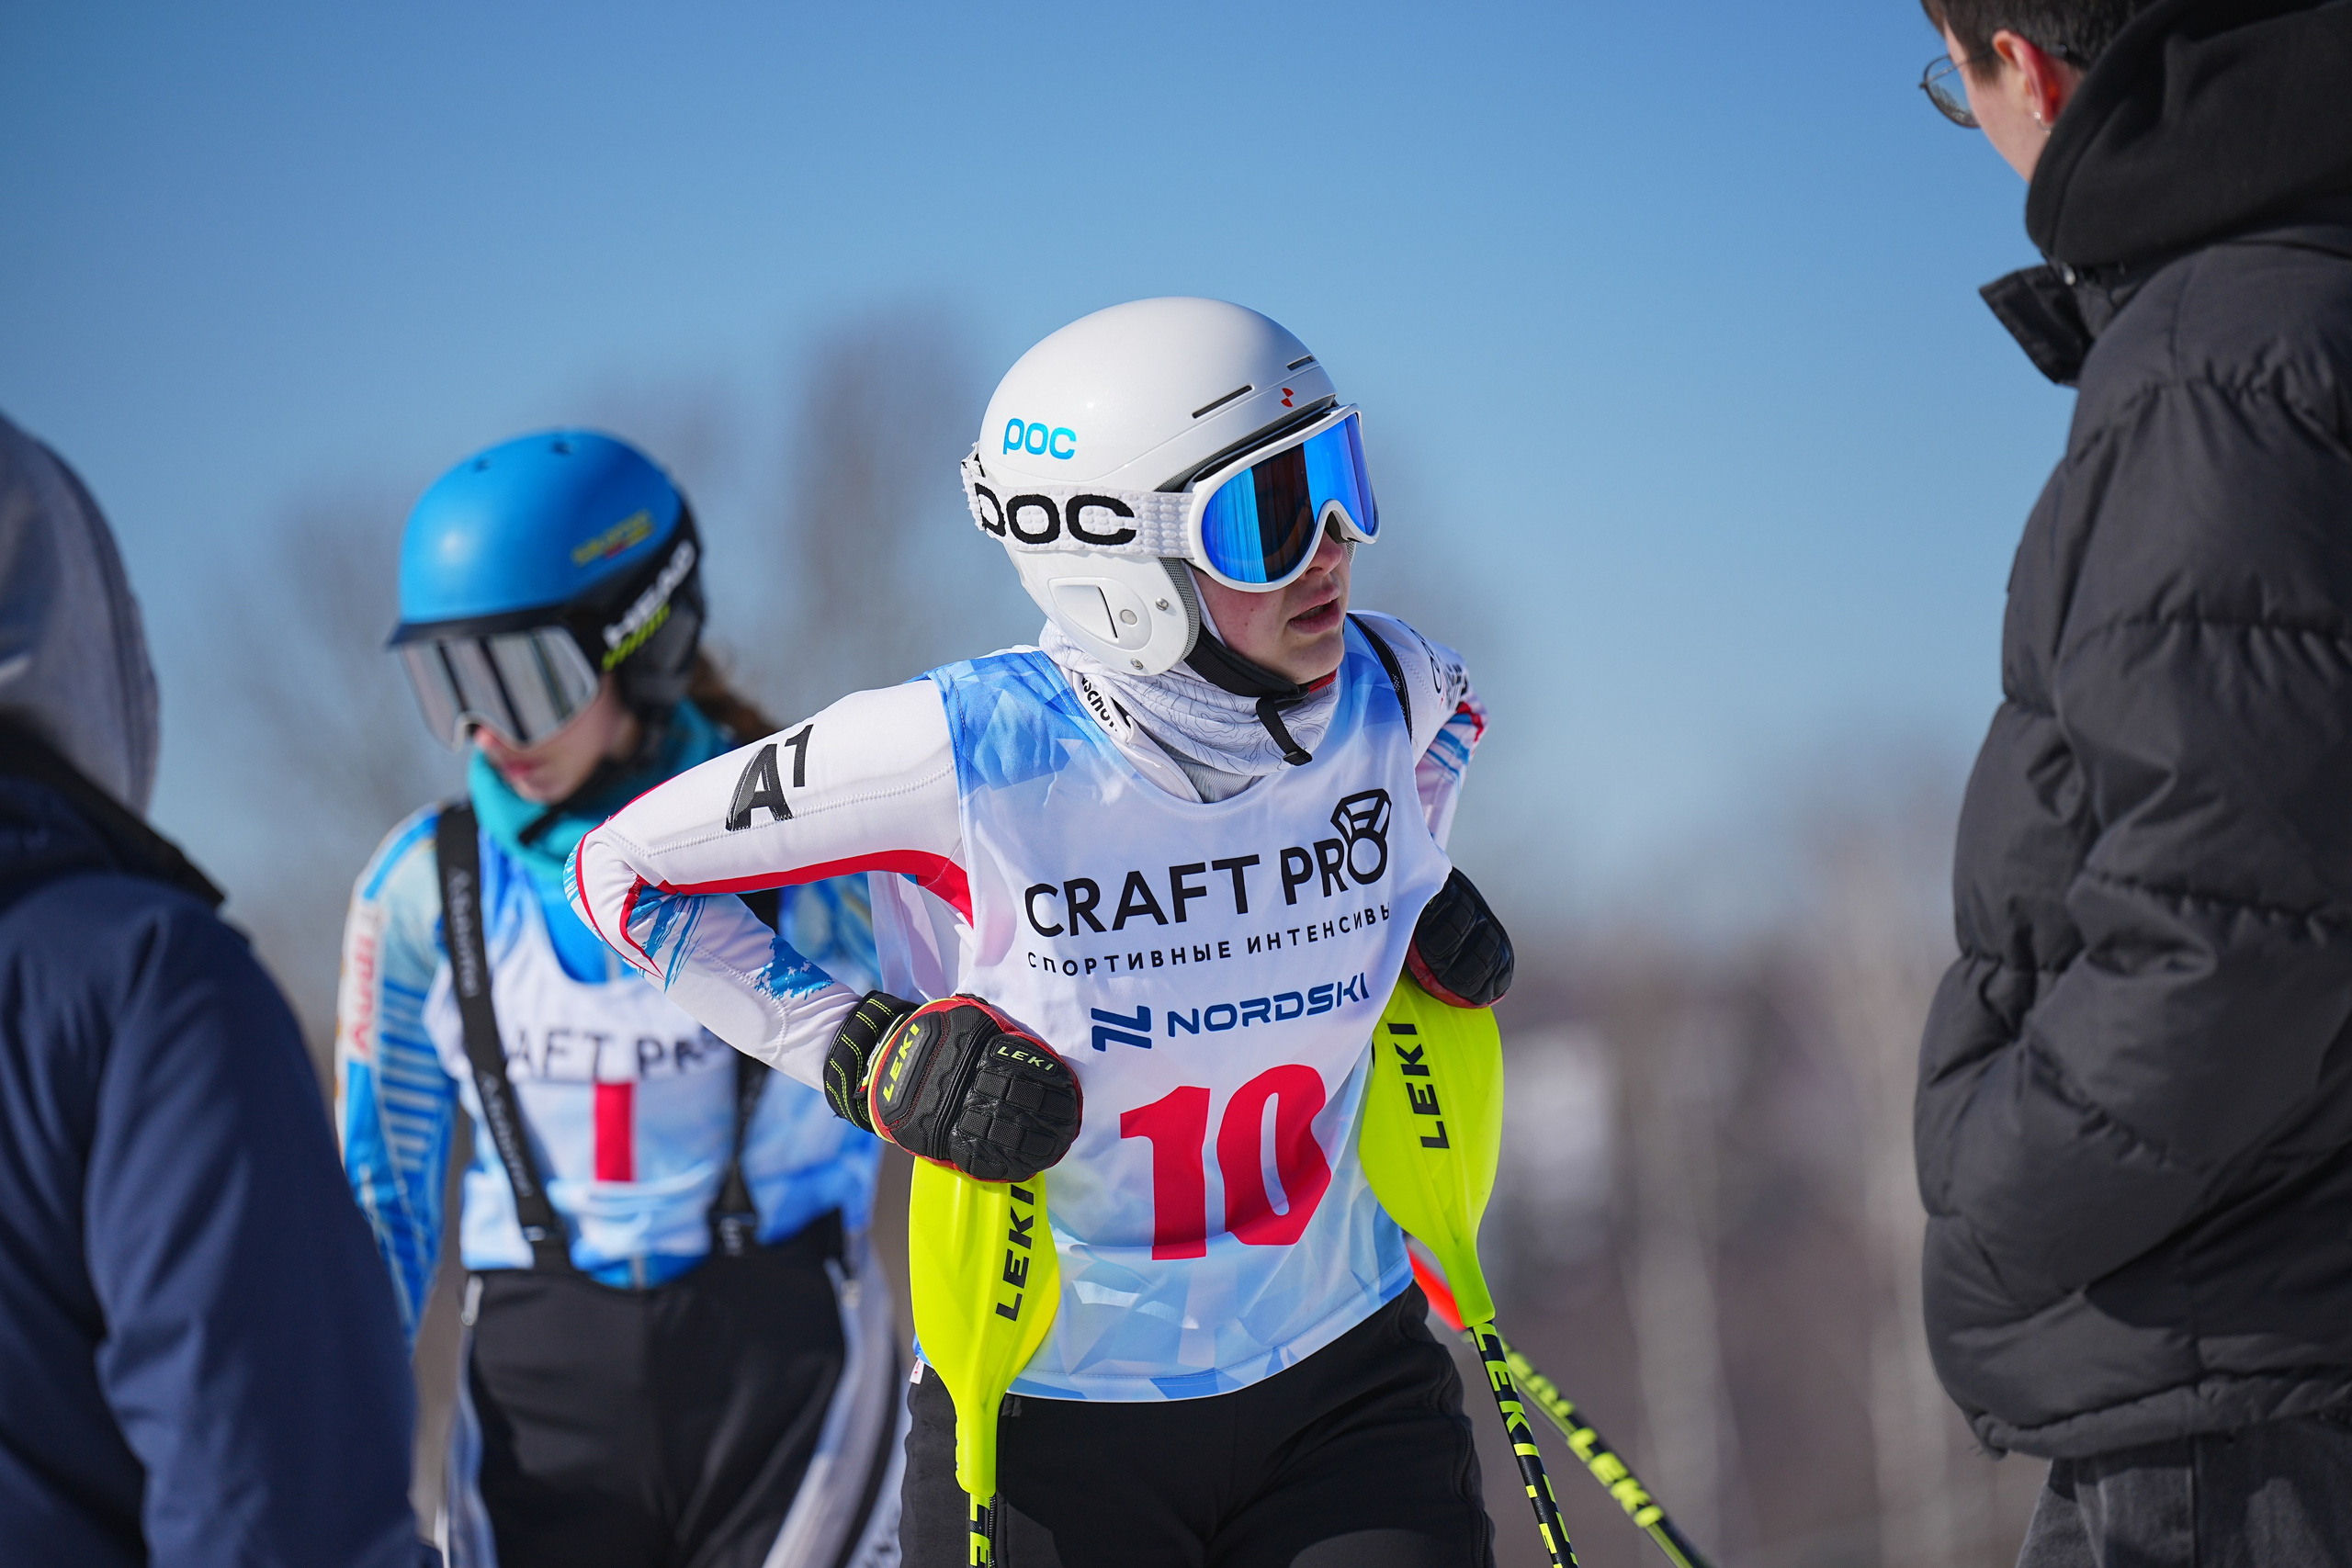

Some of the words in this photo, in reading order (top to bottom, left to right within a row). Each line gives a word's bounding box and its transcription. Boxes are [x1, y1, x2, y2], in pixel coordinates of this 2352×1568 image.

[726, 724, 814, 831] A1
[1024, 854, 1260, 937] CRAFT
[1280, 820, 1389, 905] PRO
[1027, 940, 1231, 976] СПОРТИВНЫЕ
[1168, 972, 1370, 1037] NORDSKI
[508, 1028, 611, 1081] AFT
[883, 1023, 920, 1102] LEKI
[997, 1046, 1054, 1071] LEKI
[1387, 1023, 1450, 1149] LEKI
[1119, 1064, 1331, 1261] 10
[995, 1183, 1035, 1322] LEKI
[1473, 1323, 1541, 1458] LEKI
[1566, 1427, 1664, 1529] LEKI
[969, 1494, 990, 1568] LE
